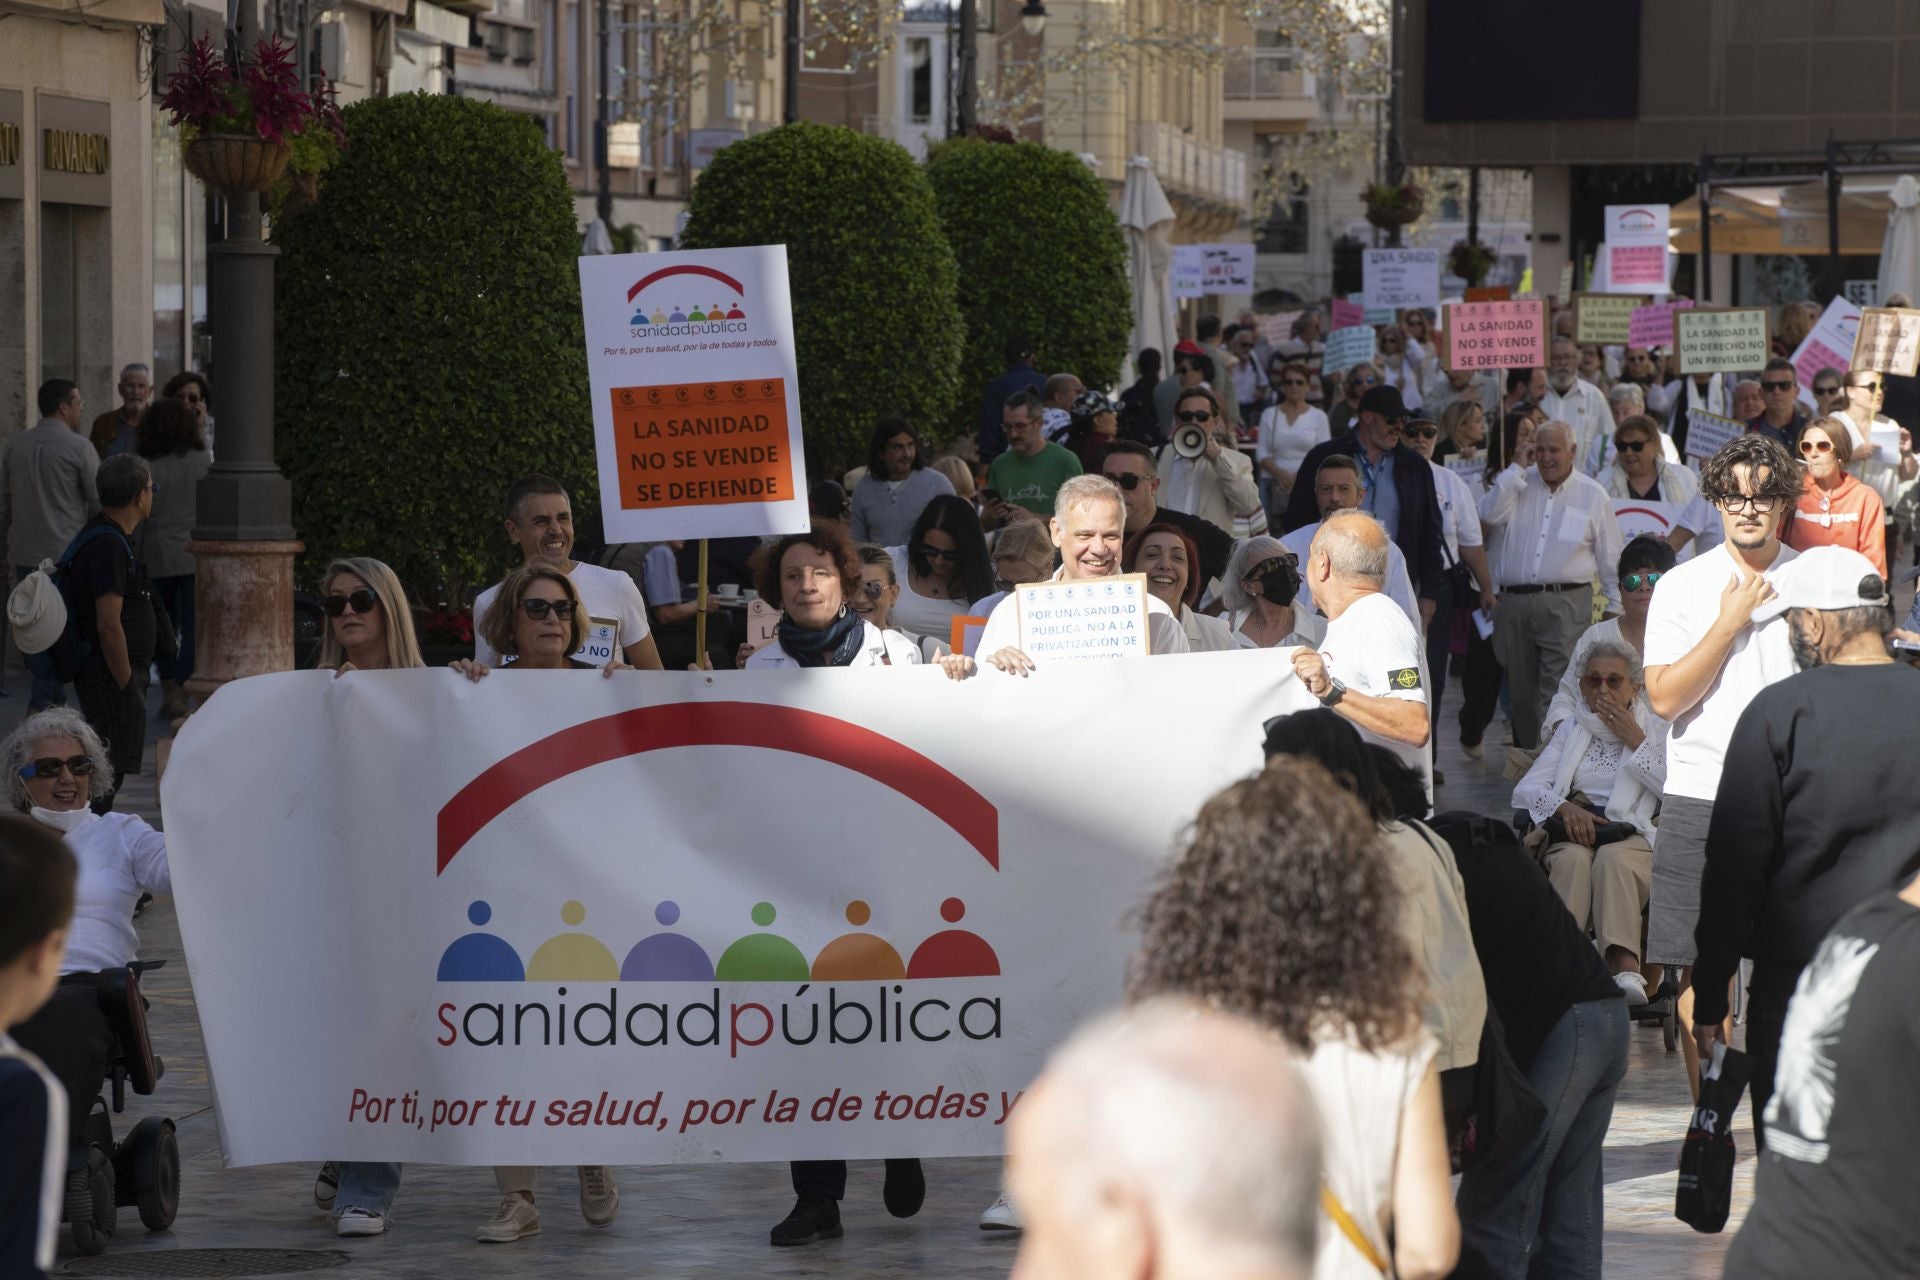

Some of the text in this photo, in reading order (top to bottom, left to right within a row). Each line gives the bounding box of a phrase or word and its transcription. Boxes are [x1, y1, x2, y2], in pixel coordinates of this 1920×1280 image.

[630, 319, 747, 339] sanidadpública
[1460, 320, 1534, 332] LA SANIDAD
[1686, 327, 1760, 338] LA SANIDAD ES
[604, 347, 619, 356] Por
[619, 345, 628, 356] ti,
[630, 346, 644, 356] por
[645, 345, 654, 354] tu
[656, 343, 681, 354] salud,
[683, 343, 698, 352] por
[700, 342, 708, 350] la
[709, 341, 720, 350] de
[721, 340, 746, 349] todas
[752, 338, 777, 348] todos
[1458, 336, 1536, 350] NO SE VENDE
[1682, 340, 1764, 352] UN DERECHO NO
[1461, 354, 1535, 366] SE DEFIENDE
[1688, 354, 1760, 365] UN PRIVILEGIO
[633, 415, 769, 440] LA SANIDAD
[631, 445, 778, 470] NO SE VENDE
[637, 477, 778, 502] SE DEFIENDE
[1028, 604, 1136, 620] POR UNA SANIDAD
[1088, 622, 1105, 632] NO
[1109, 622, 1117, 630] A
[1120, 620, 1134, 630] LA
[1122, 636, 1137, 646] DE
[590, 646, 610, 658] NO
[437, 984, 1001, 1059] sanidadpública
[348, 1086, 1023, 1134] Por ti, por tu salud, por la de todas y
